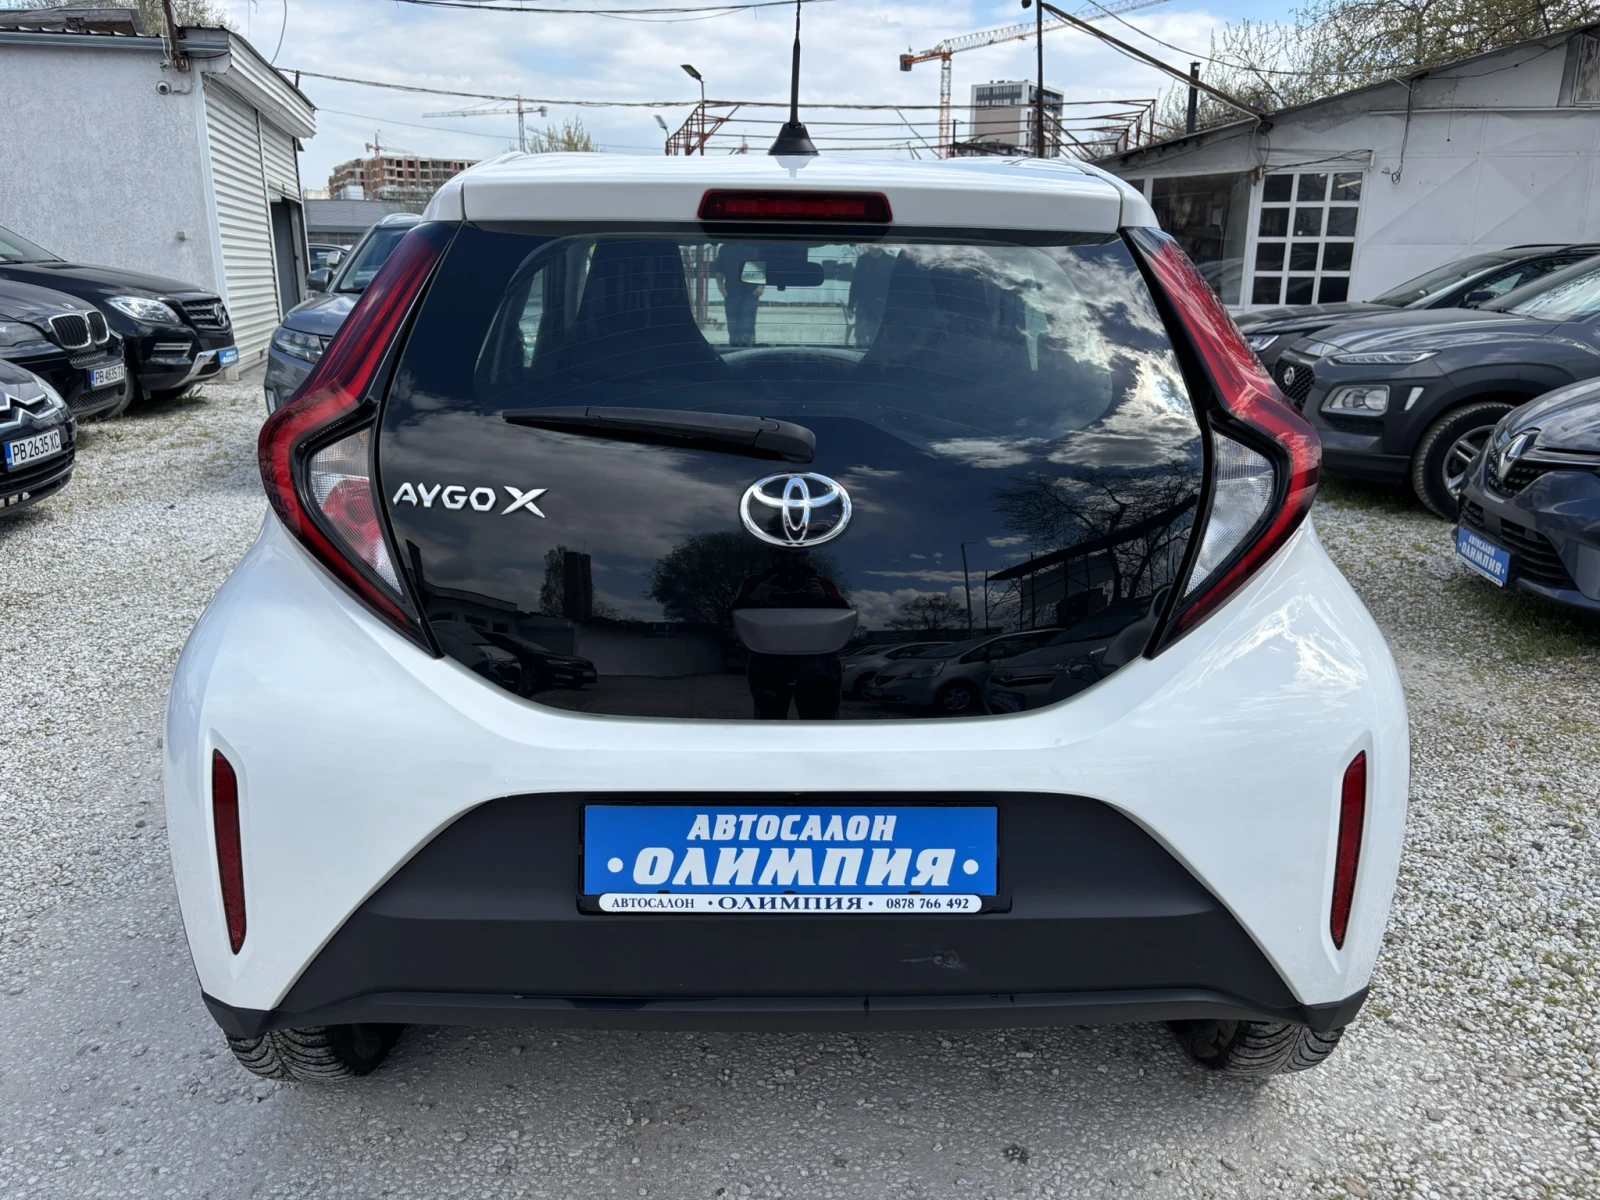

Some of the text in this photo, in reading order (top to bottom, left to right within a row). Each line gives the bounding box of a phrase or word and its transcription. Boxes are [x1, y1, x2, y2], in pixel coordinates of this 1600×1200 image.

[13, 432, 59, 462] PB 2635 XC
[393, 482, 549, 518] AYGO X
[1461, 541, 1503, 576] ОЛИМПИЯ
[686, 813, 898, 842] АВТОСАЛОН
[632, 846, 957, 887] ОЛИМПИЯ
[611, 896, 969, 910] АВТОСАЛОН ОЛИМПИЯ 0878 766 492
